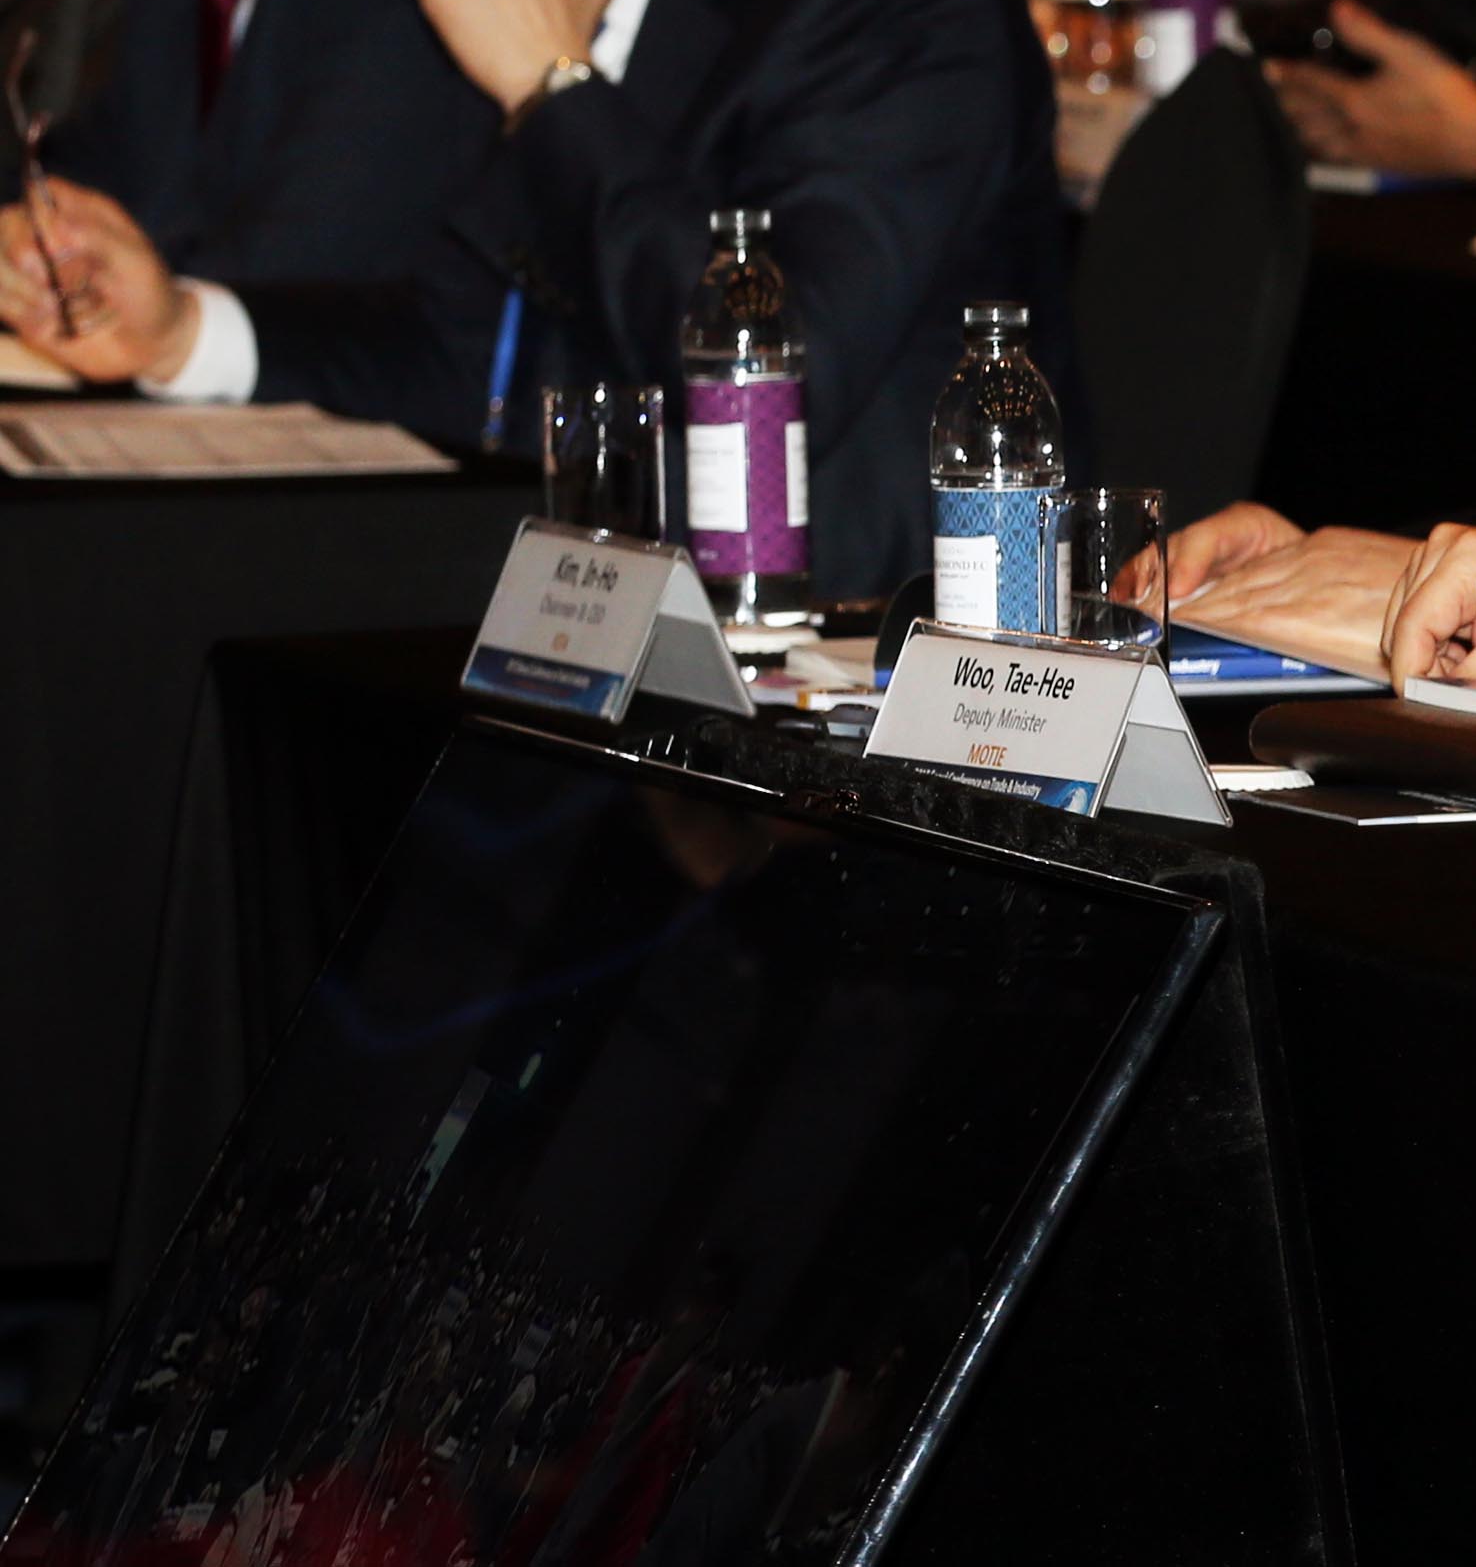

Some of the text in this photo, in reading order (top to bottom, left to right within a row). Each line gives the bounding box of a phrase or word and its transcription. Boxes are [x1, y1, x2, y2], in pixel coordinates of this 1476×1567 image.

[952, 656, 1076, 701] Woo, Tae-Hee
[952, 702, 1048, 734] Deputy Minister
[966, 743, 1008, 768] MOTIE
[1013, 779, 1042, 801] Industry
